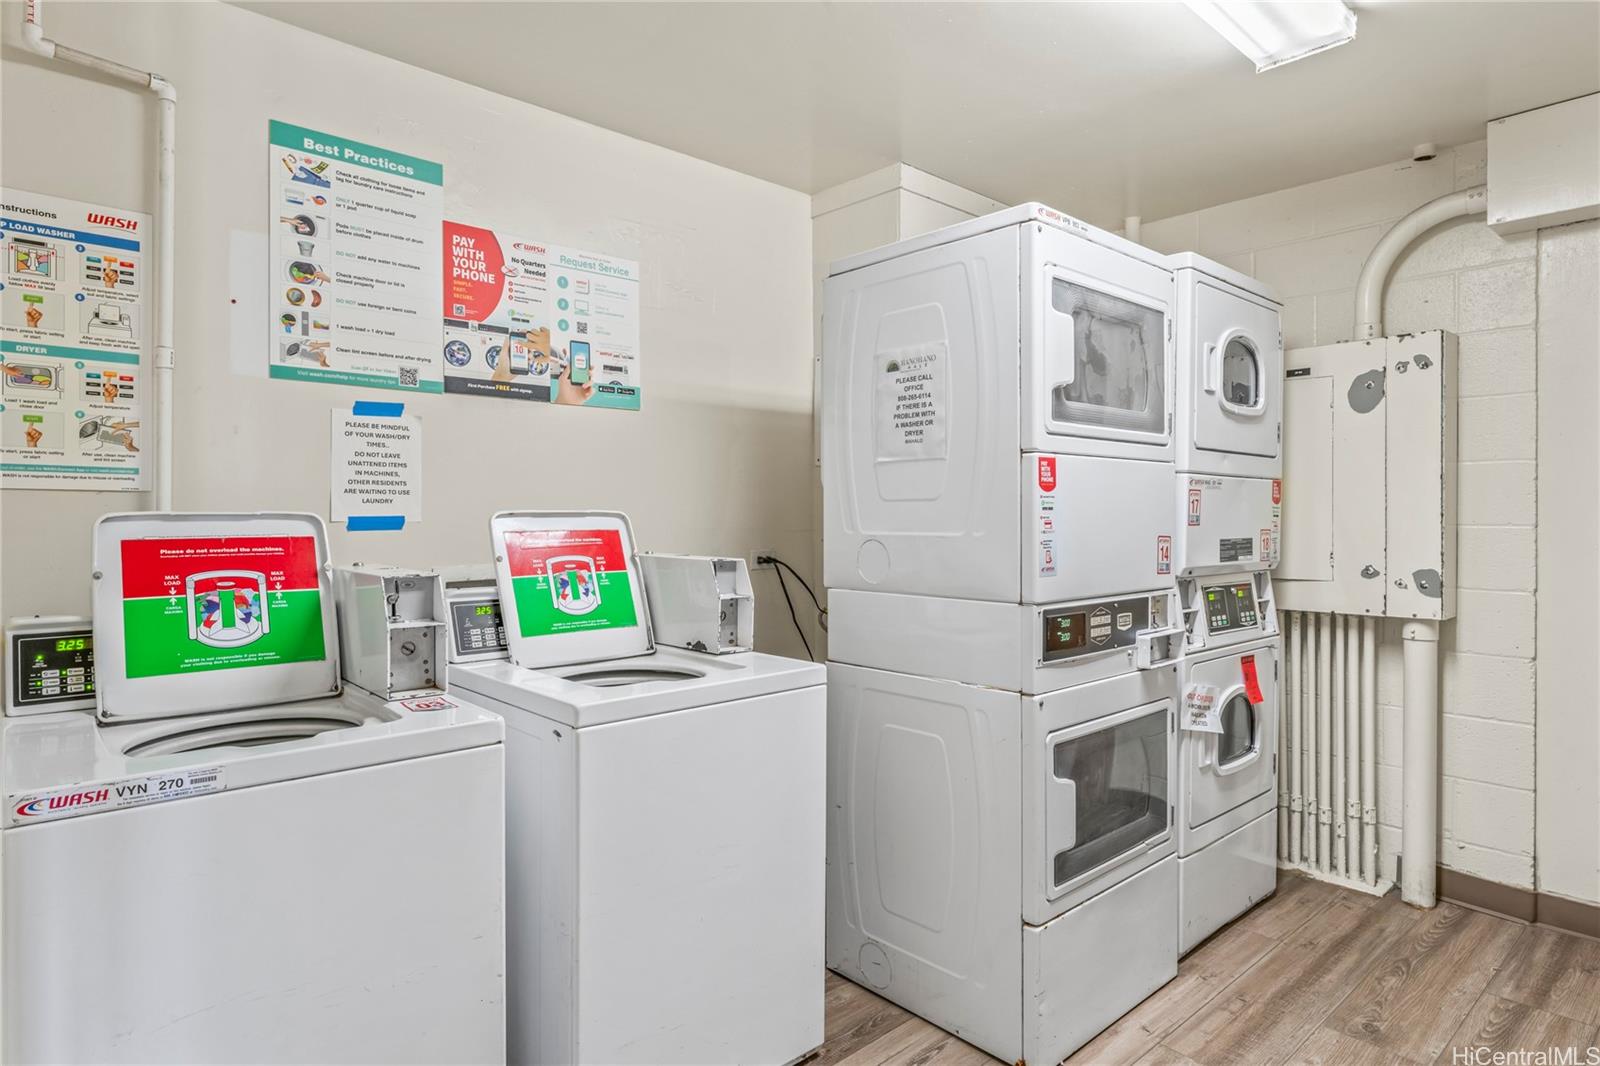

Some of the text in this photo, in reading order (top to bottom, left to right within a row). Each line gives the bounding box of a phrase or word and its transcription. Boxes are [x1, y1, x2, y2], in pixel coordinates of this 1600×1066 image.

[304, 137, 414, 175] Best Practices
[336, 170, 351, 178] Check
[360, 177, 380, 186] clothing
[353, 180, 372, 189] laundry
[385, 188, 413, 198] instructions
[87, 213, 138, 230] WASH
[9, 222, 34, 231] LOAD
[37, 225, 75, 239] WASHER
[452, 235, 475, 248] PAY
[524, 244, 545, 253] WASH
[452, 246, 484, 261] WITH
[398, 262, 420, 270] machines
[452, 256, 486, 272] YOUR
[520, 259, 546, 269] Quarters
[560, 255, 596, 270] Request
[599, 262, 629, 277] Service
[453, 267, 495, 284] PHONE
[524, 268, 546, 278] Needed
[16, 344, 47, 354] DRYER
[514, 345, 523, 354] 10
[896, 373, 933, 384] PLEASE CALL
[904, 384, 924, 393] OFFICE
[893, 410, 936, 420] PROBLEM WITH
[345, 421, 370, 429] PLEASE
[381, 424, 410, 432] MINDFUL
[905, 429, 924, 437] DRYER
[348, 460, 387, 468] UNATTENED
[1191, 499, 1199, 514] 17
[1160, 545, 1169, 562] 14
[116, 783, 147, 797] VYN
[159, 778, 184, 791] 270
[49, 789, 109, 809] WASH
